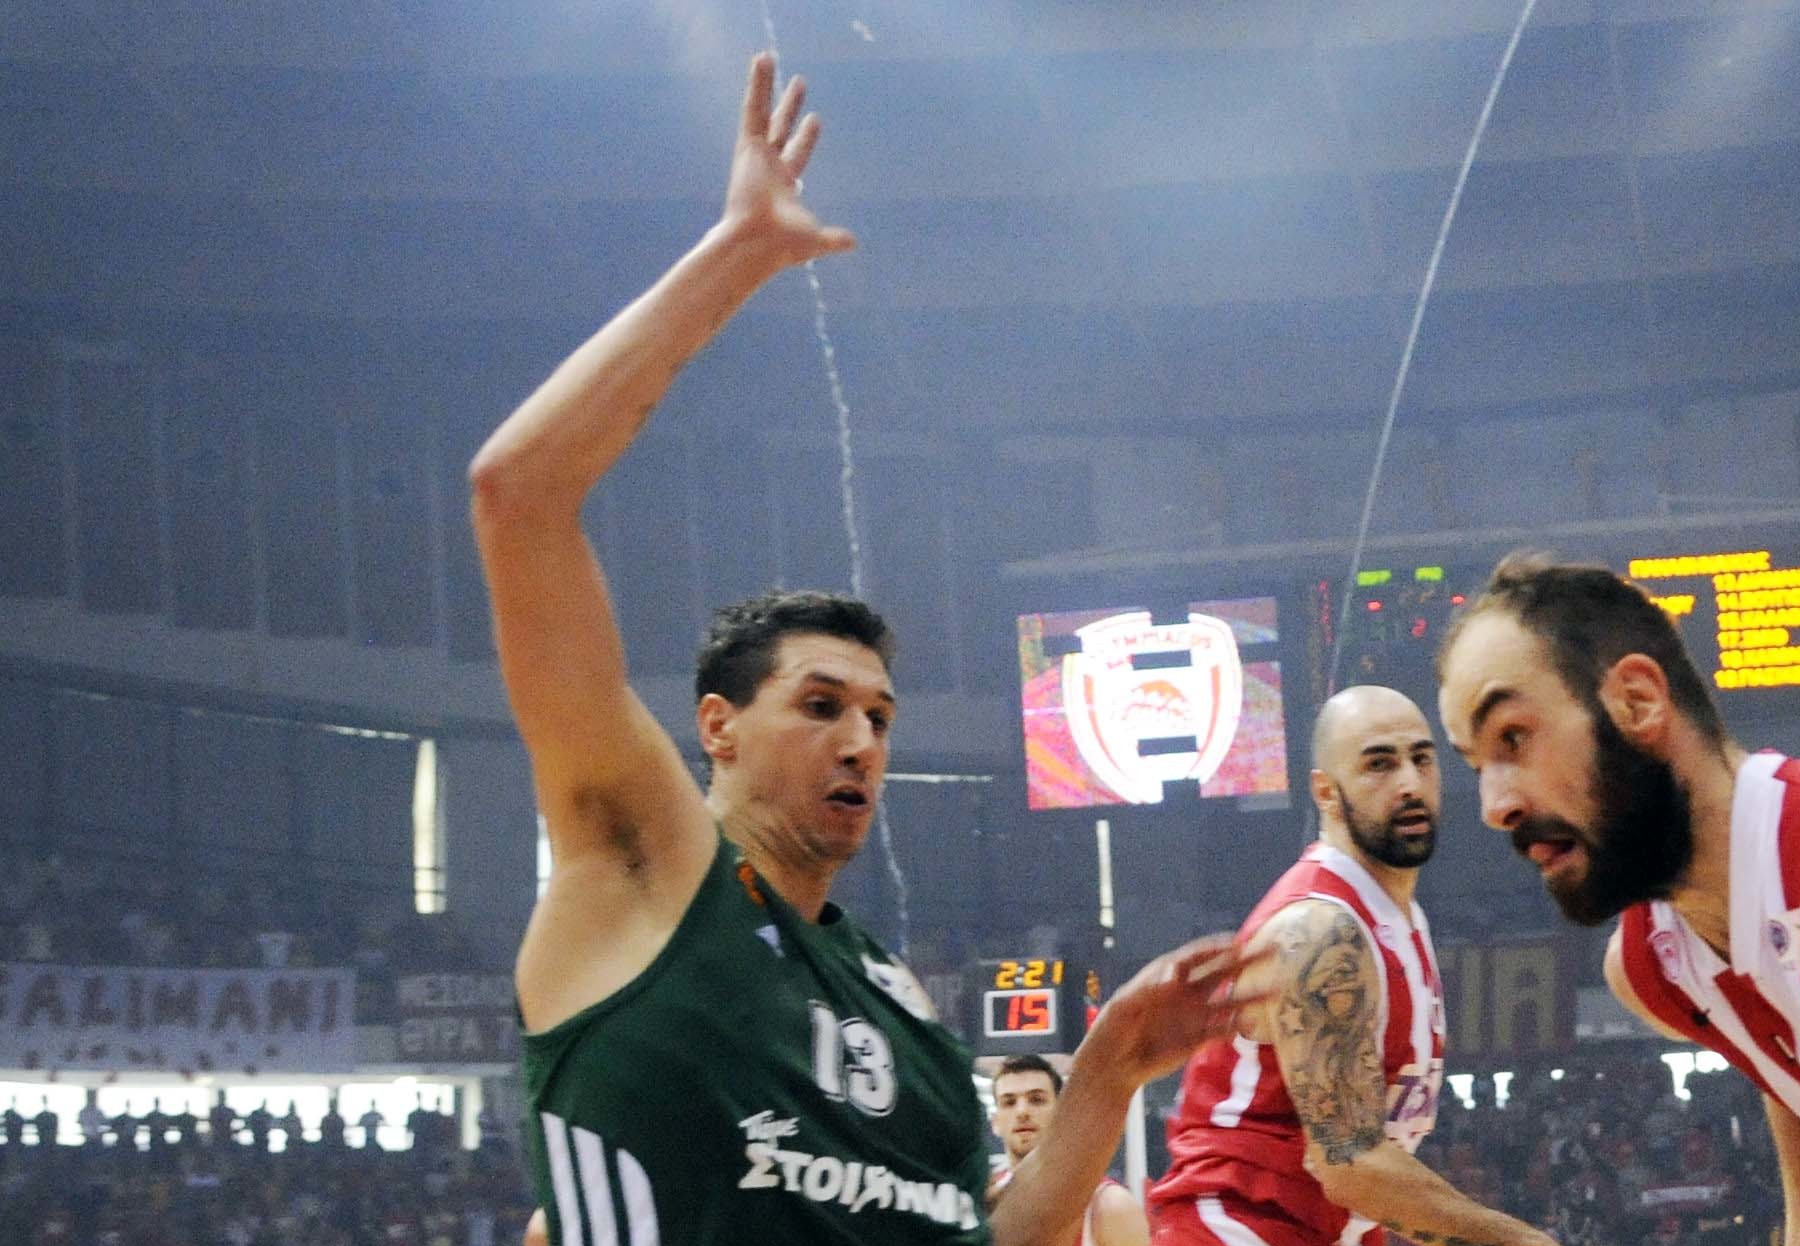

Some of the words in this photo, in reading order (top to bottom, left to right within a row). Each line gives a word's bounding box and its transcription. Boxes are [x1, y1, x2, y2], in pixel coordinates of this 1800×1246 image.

[995, 959, 1065, 989] 2:21
[0, 968, 339, 1032] ALIMANI
[1006, 993, 1050, 1031] 15
[808, 998, 897, 1118] 13
